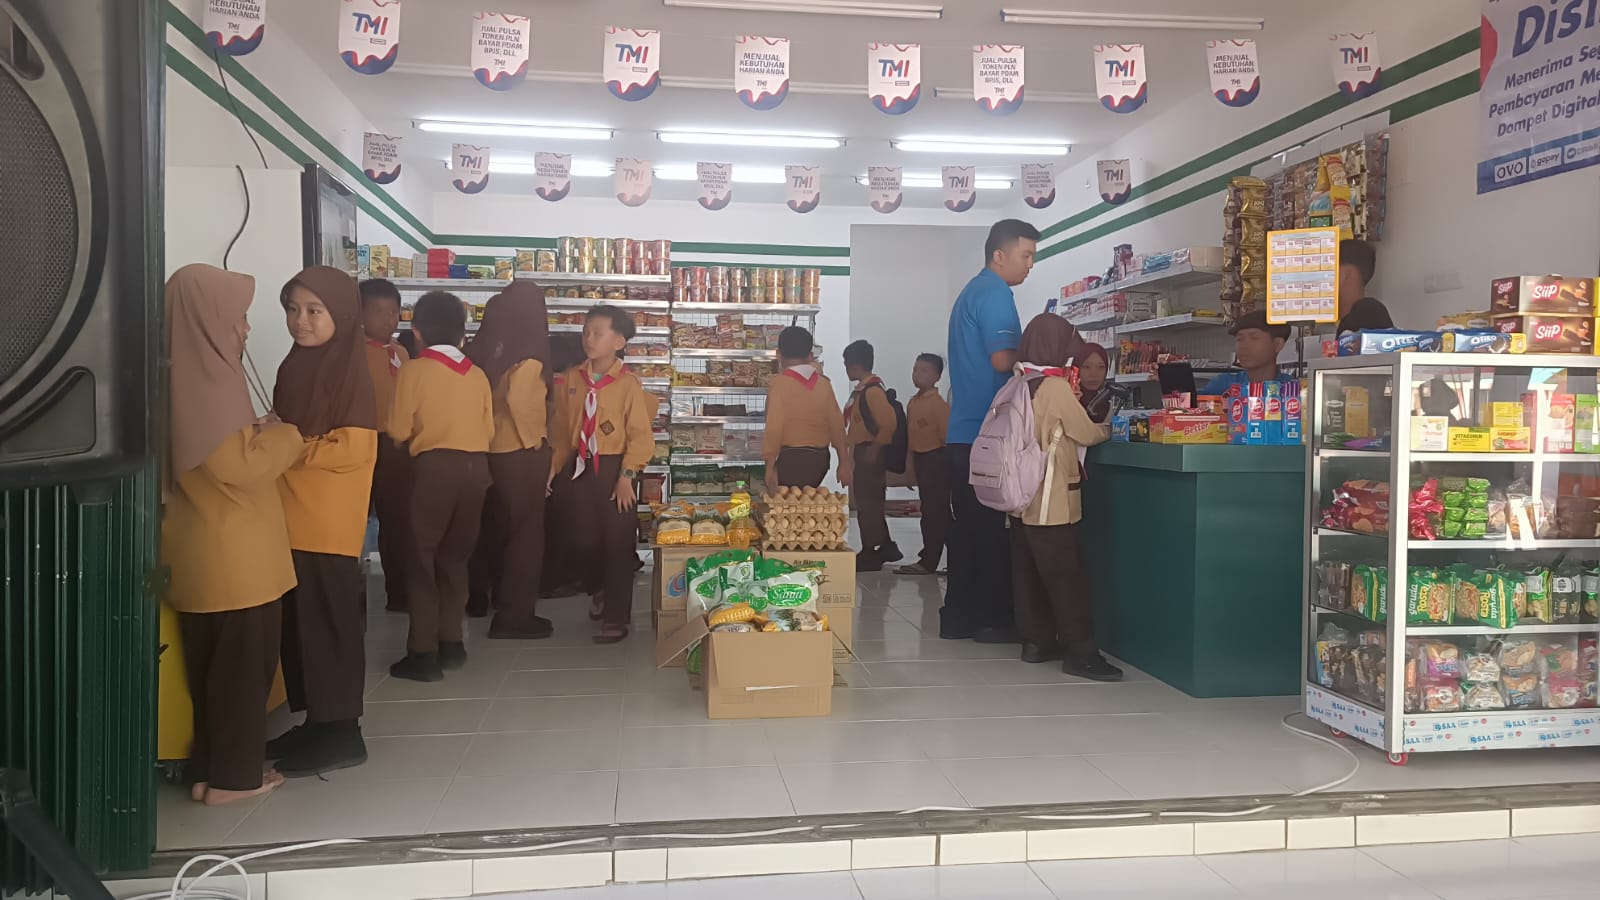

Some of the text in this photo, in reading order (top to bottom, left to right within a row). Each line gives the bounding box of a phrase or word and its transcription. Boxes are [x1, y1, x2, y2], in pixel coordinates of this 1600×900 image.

[209, 0, 260, 13] KEBUTUHAN
[209, 6, 238, 17] HARIAN
[227, 22, 240, 30] TMI
[352, 12, 388, 35] TMI
[498, 27, 521, 36] PULSA
[615, 43, 649, 64] TMI
[743, 52, 780, 61] MENJUAL
[1216, 54, 1249, 62] MENJUAL
[1339, 46, 1369, 64] TMI
[740, 60, 785, 69] KEBUTUHAN
[878, 59, 910, 77] TMI
[1104, 59, 1135, 78] TMI
[1213, 61, 1254, 69] KEBUTUHAN
[1504, 55, 1574, 91] Menerima
[1488, 78, 1575, 118] Pembayaran
[1497, 87, 1600, 137] Dompet Digital
[459, 155, 482, 169] TMI
[1536, 153, 1560, 167] gopay
[623, 168, 644, 181] TMI
[1104, 169, 1123, 181] TMI
[1497, 161, 1523, 179] OVO
[792, 175, 813, 188] TMI
[949, 175, 969, 189] TMI
[1184, 422, 1209, 436] Better
[1409, 584, 1418, 615] garuda
[1489, 587, 1497, 619] garuda
